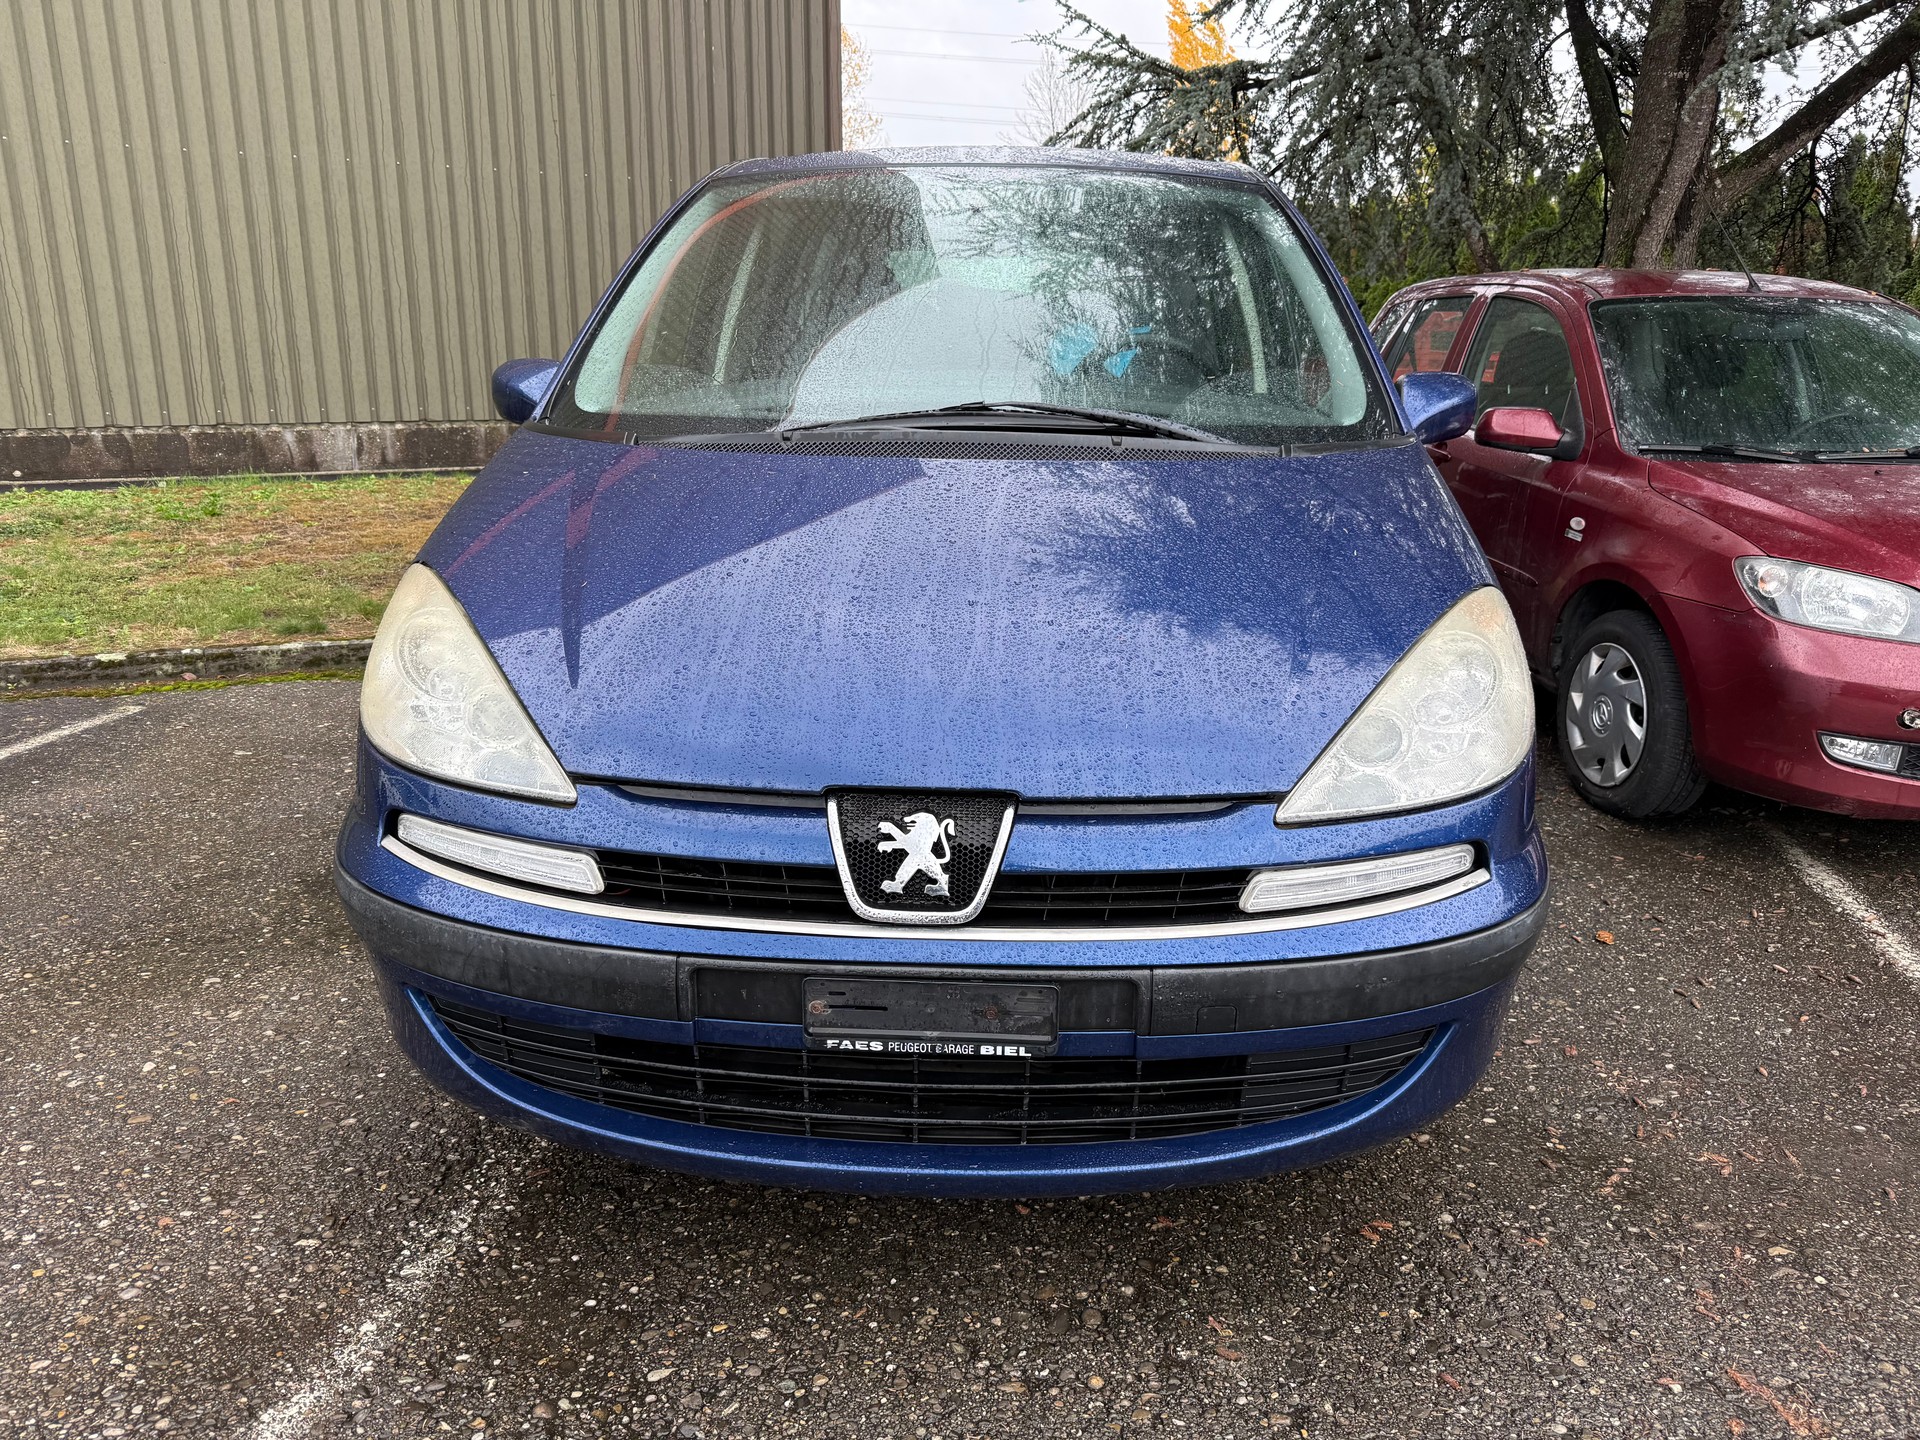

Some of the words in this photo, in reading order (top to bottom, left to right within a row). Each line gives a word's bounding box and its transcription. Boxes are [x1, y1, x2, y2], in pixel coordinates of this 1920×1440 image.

[826, 1039, 884, 1051] FAES
[888, 1042, 933, 1053] PEUGEOT
[935, 1043, 975, 1055] GARAGE
[980, 1045, 1032, 1057] BIEL
